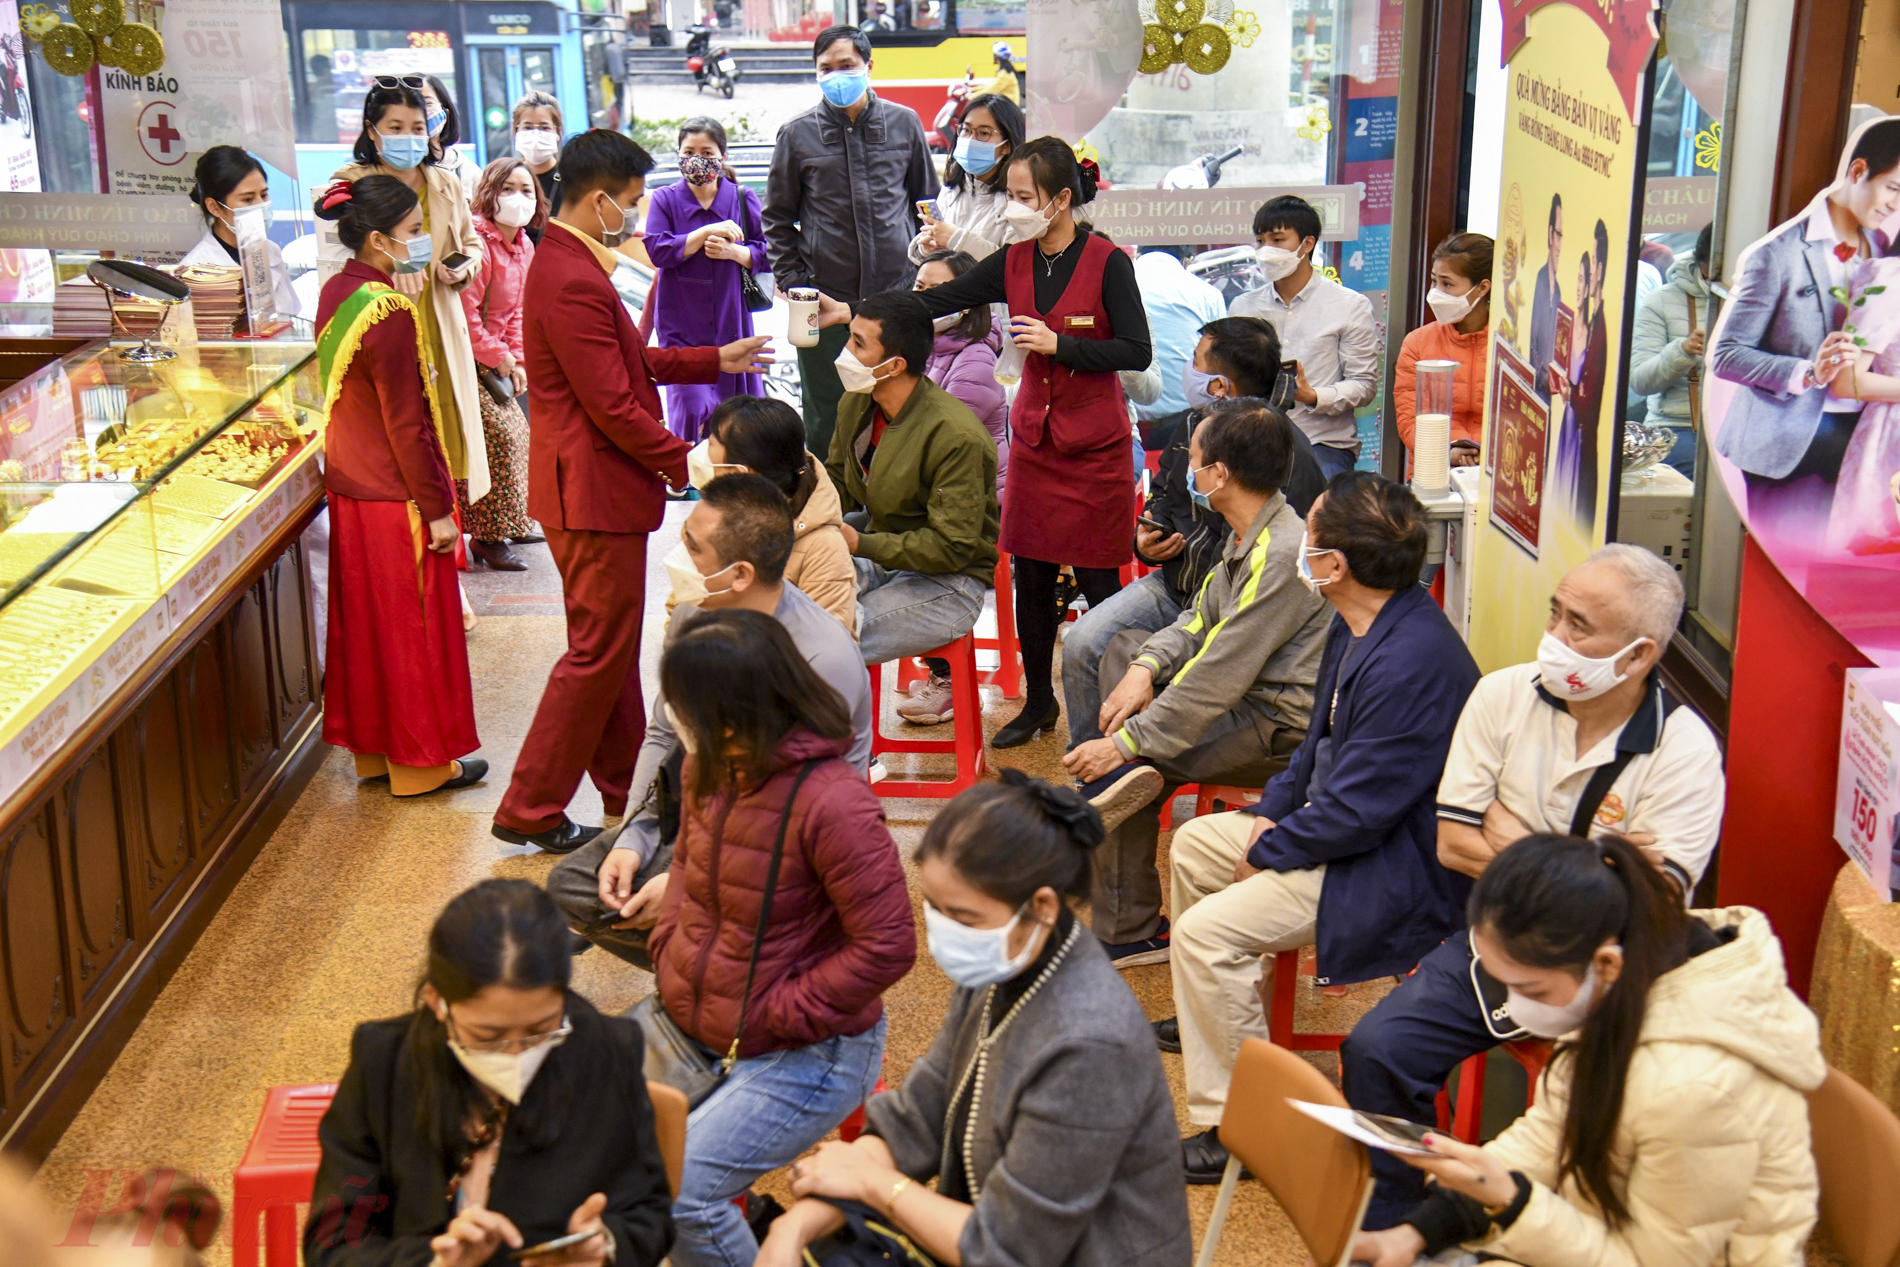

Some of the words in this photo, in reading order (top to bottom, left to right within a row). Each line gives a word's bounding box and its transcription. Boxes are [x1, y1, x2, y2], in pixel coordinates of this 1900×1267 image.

[105, 69, 142, 91] KÍNH
[147, 72, 179, 93] BÁO
[1355, 117, 1368, 136] 2
[1645, 184, 1712, 206] CHÂU
[1642, 211, 1687, 226] HÁCH
[1349, 250, 1364, 271] 4
[1852, 787, 1877, 843] 150
